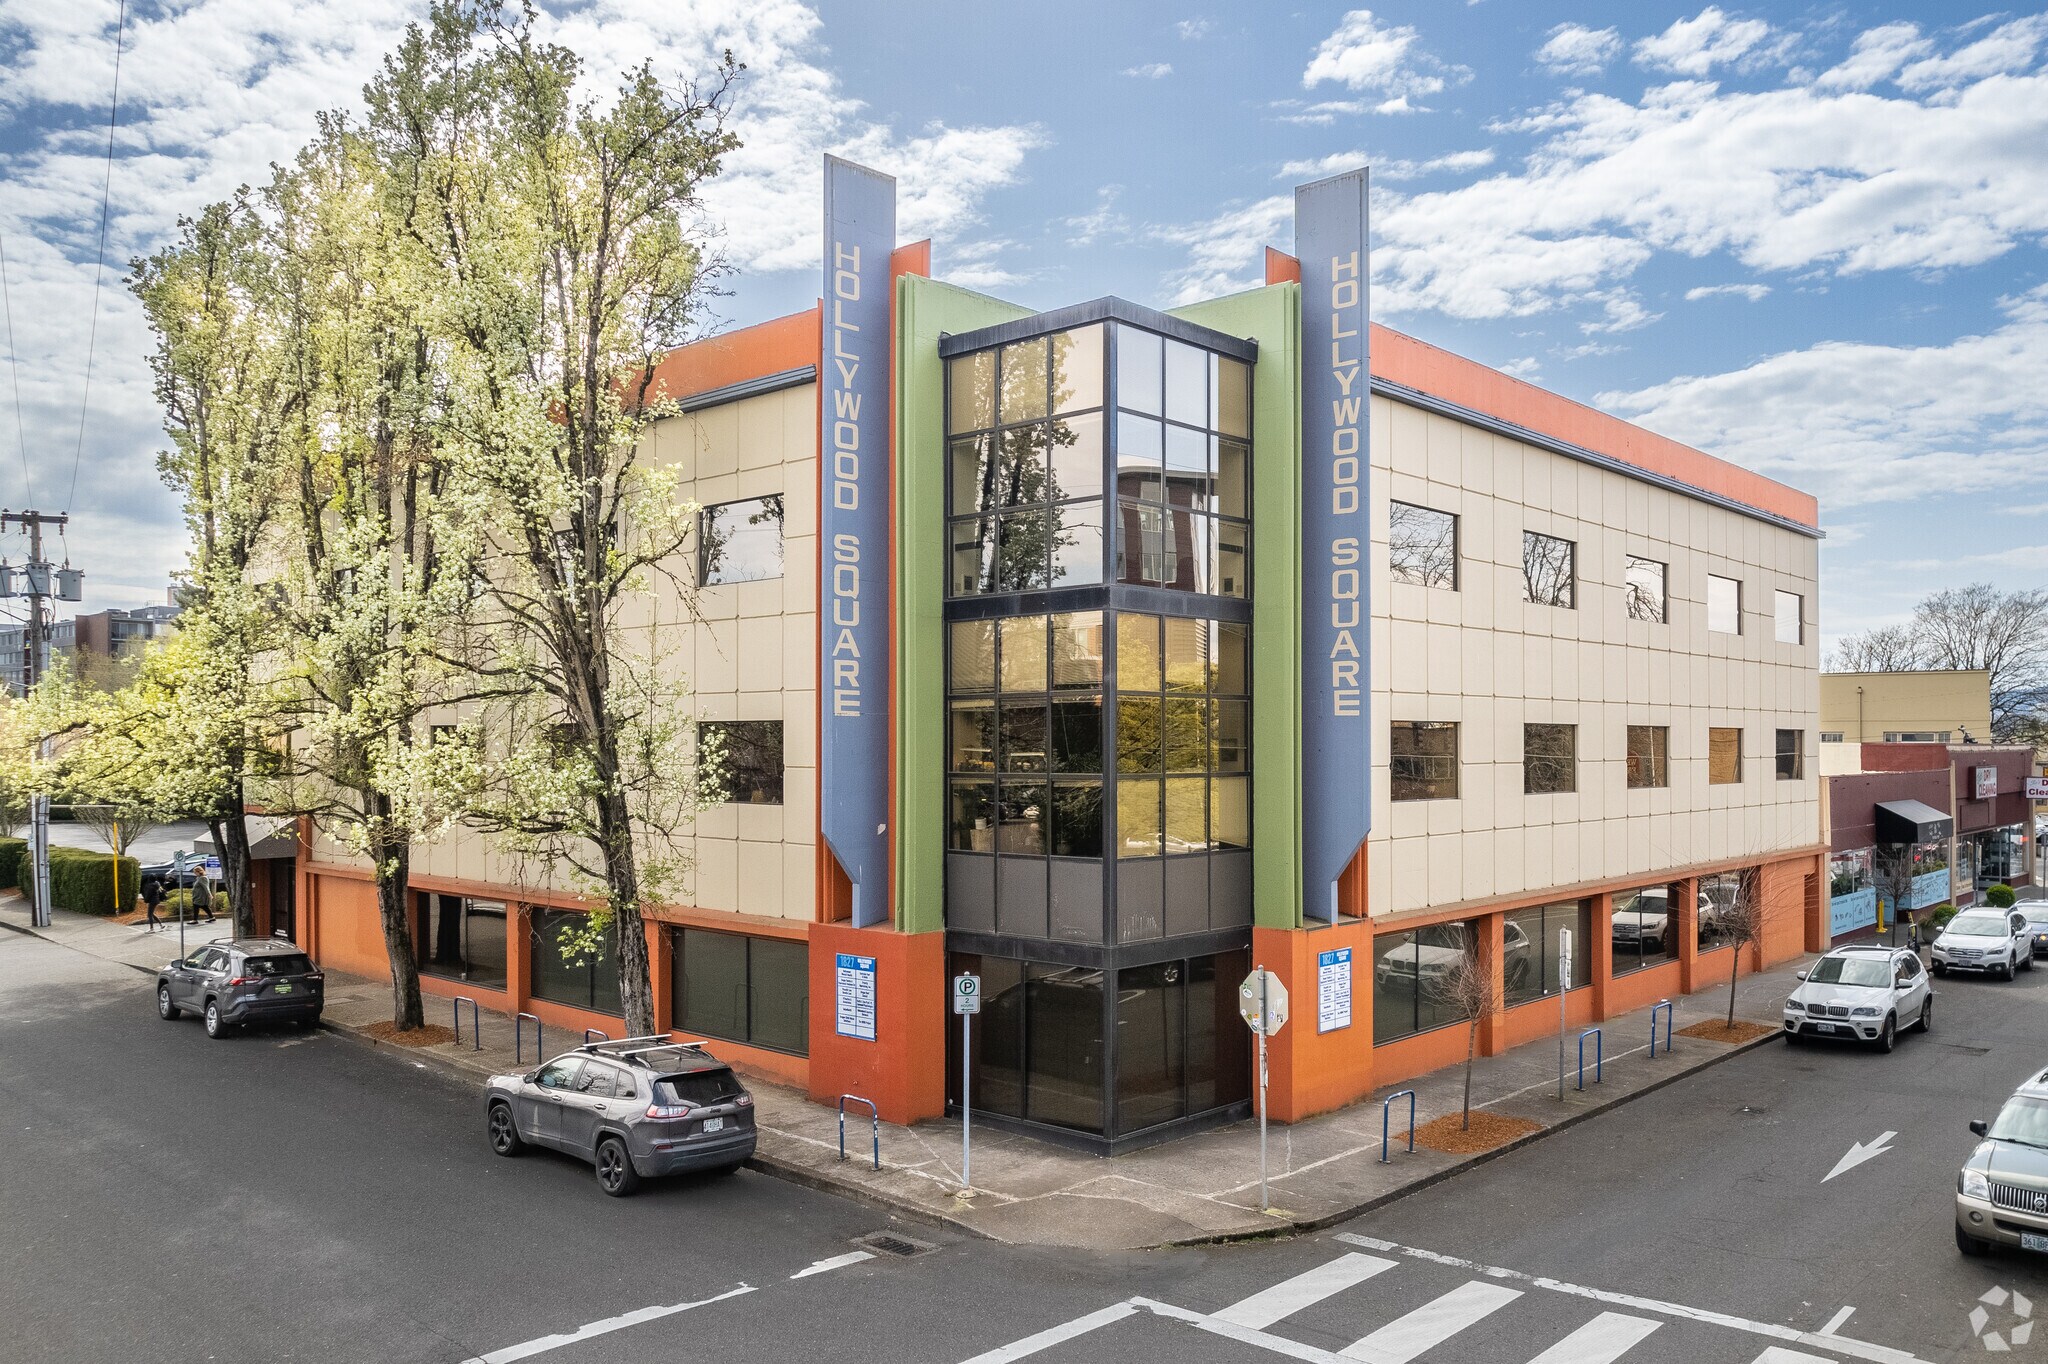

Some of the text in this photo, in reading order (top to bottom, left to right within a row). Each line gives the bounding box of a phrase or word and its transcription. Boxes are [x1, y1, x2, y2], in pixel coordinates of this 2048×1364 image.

[832, 241, 862, 717] HOLLYWOOD SQUARE
[1330, 250, 1362, 716] HOLLYWOOD SQUARE
[1983, 769, 1992, 781] DRY
[840, 955, 855, 968] 1827
[1322, 953, 1334, 965] 1827
[964, 982, 972, 991] P
[2023, 1236, 2036, 1247] 361
